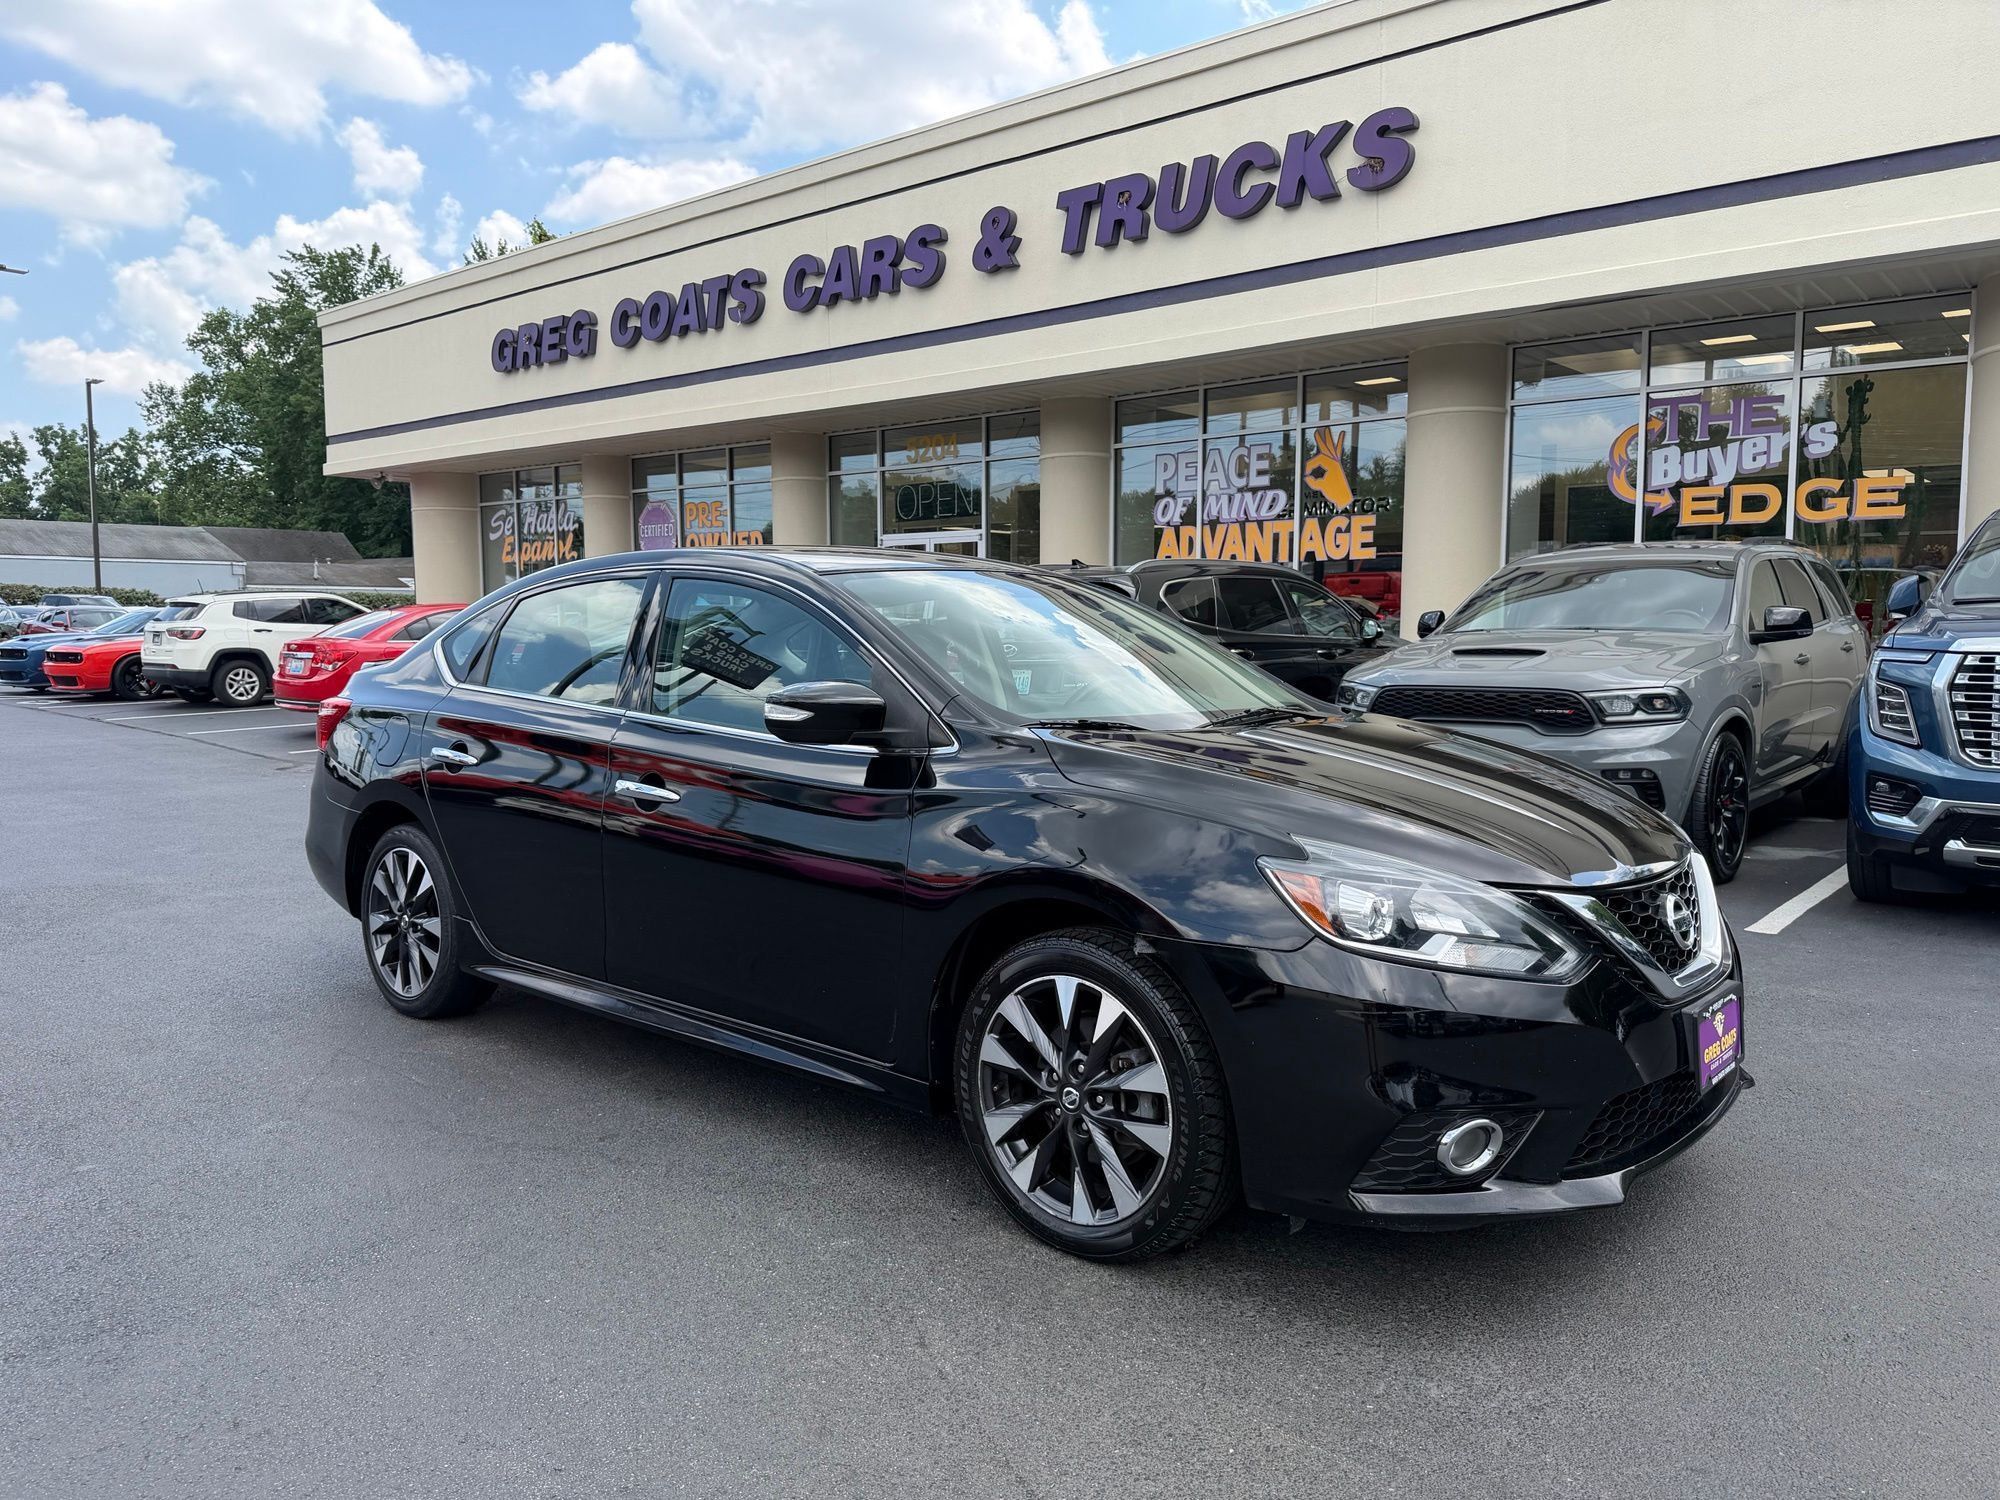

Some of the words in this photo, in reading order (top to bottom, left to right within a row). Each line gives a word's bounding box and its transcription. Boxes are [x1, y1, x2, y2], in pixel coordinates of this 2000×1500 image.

[491, 309, 598, 373] GREG
[610, 268, 767, 348] COATS
[783, 224, 949, 313] CARS
[972, 205, 1023, 274] &
[1056, 106, 1420, 254] TRUCKS
[1648, 393, 1785, 445] THE
[905, 433, 961, 465] 5204
[1647, 420, 1839, 490] Buyer's
[1154, 443, 1272, 495] PEACE
[684, 501, 728, 530] PRE-
[897, 480, 974, 520] OPEN
[1154, 495, 1195, 525] OF
[1202, 488, 1288, 523] MIND
[1676, 476, 1907, 527] EDGE
[489, 506, 514, 541] Se
[523, 502, 579, 535] Habla
[640, 522, 674, 538] CERTIFIED
[1155, 514, 1377, 563] ADVANTAGE
[502, 532, 578, 569] Epañol
[1704, 1041, 1721, 1064] GREG
